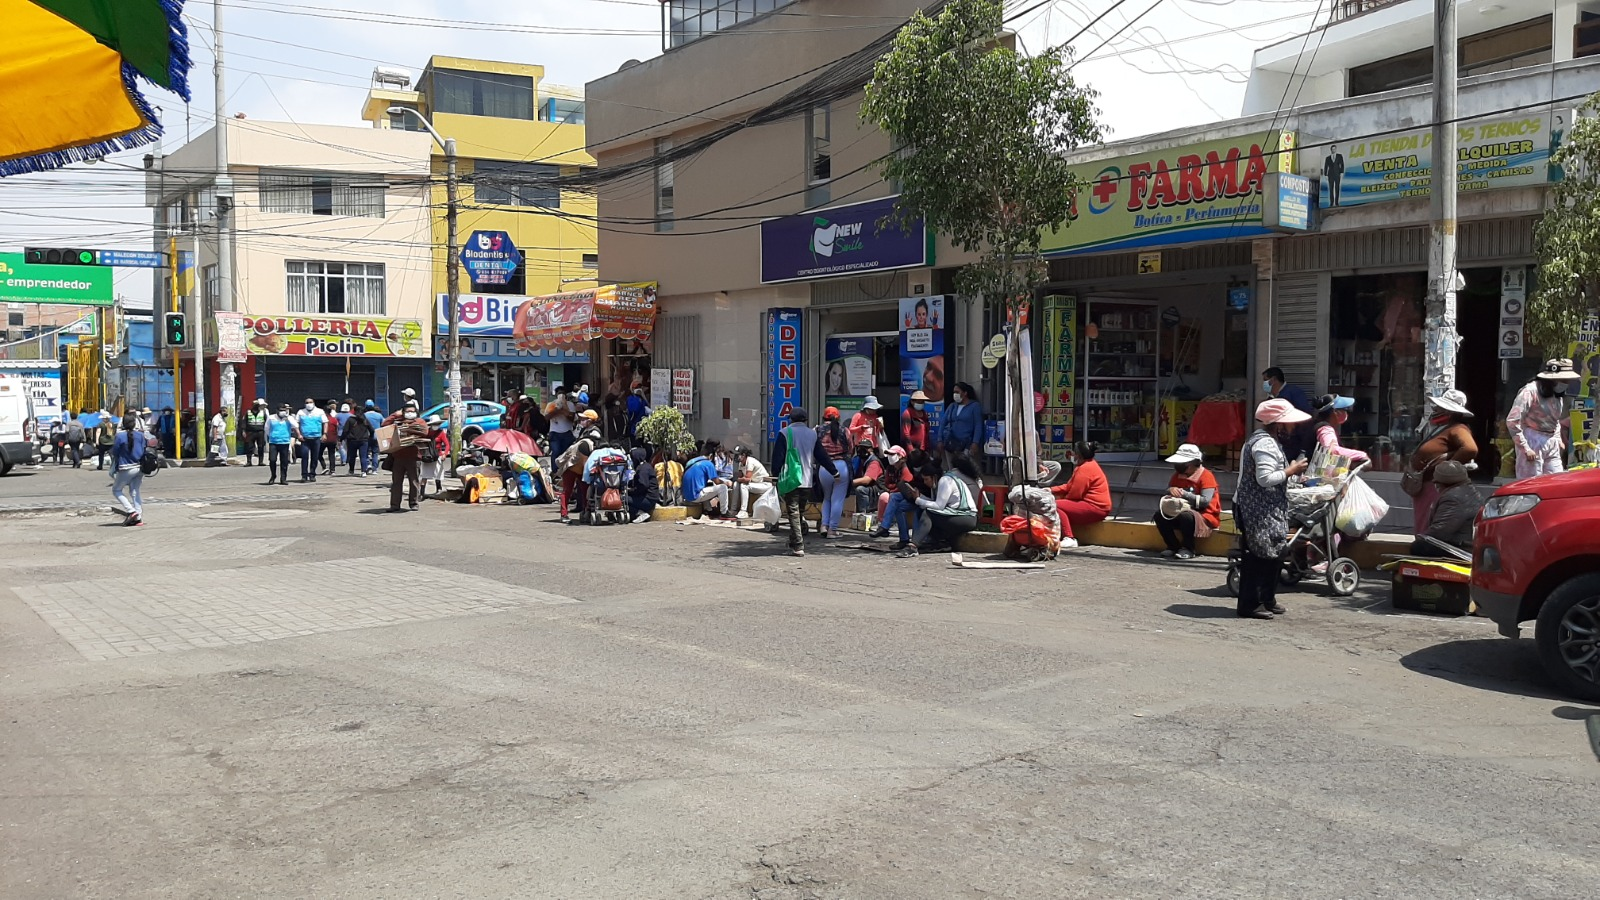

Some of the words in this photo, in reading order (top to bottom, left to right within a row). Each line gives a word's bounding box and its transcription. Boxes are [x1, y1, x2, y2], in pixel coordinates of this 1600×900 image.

[1349, 143, 1365, 159] LA
[1370, 135, 1418, 155] TIENDA
[1421, 133, 1433, 148] D
[1480, 118, 1541, 139] TERNOS
[1362, 154, 1418, 174] VENTA
[1383, 168, 1433, 181] CONFECCIO
[1468, 159, 1508, 171] MEDIDA
[1127, 143, 1266, 211] FARMA
[1361, 182, 1398, 193] BLEIZER
[1487, 166, 1534, 179] CAMISAS
[1400, 187, 1432, 198] TERNO
[1458, 181, 1489, 191] DAMA
[836, 222, 862, 238] NEW
[1134, 213, 1173, 229] Botica
[834, 236, 864, 254] Smile
[6, 278, 93, 291] emprendedor
[597, 299, 652, 309] CHANCHO
[1058, 311, 1073, 388] FARMA
